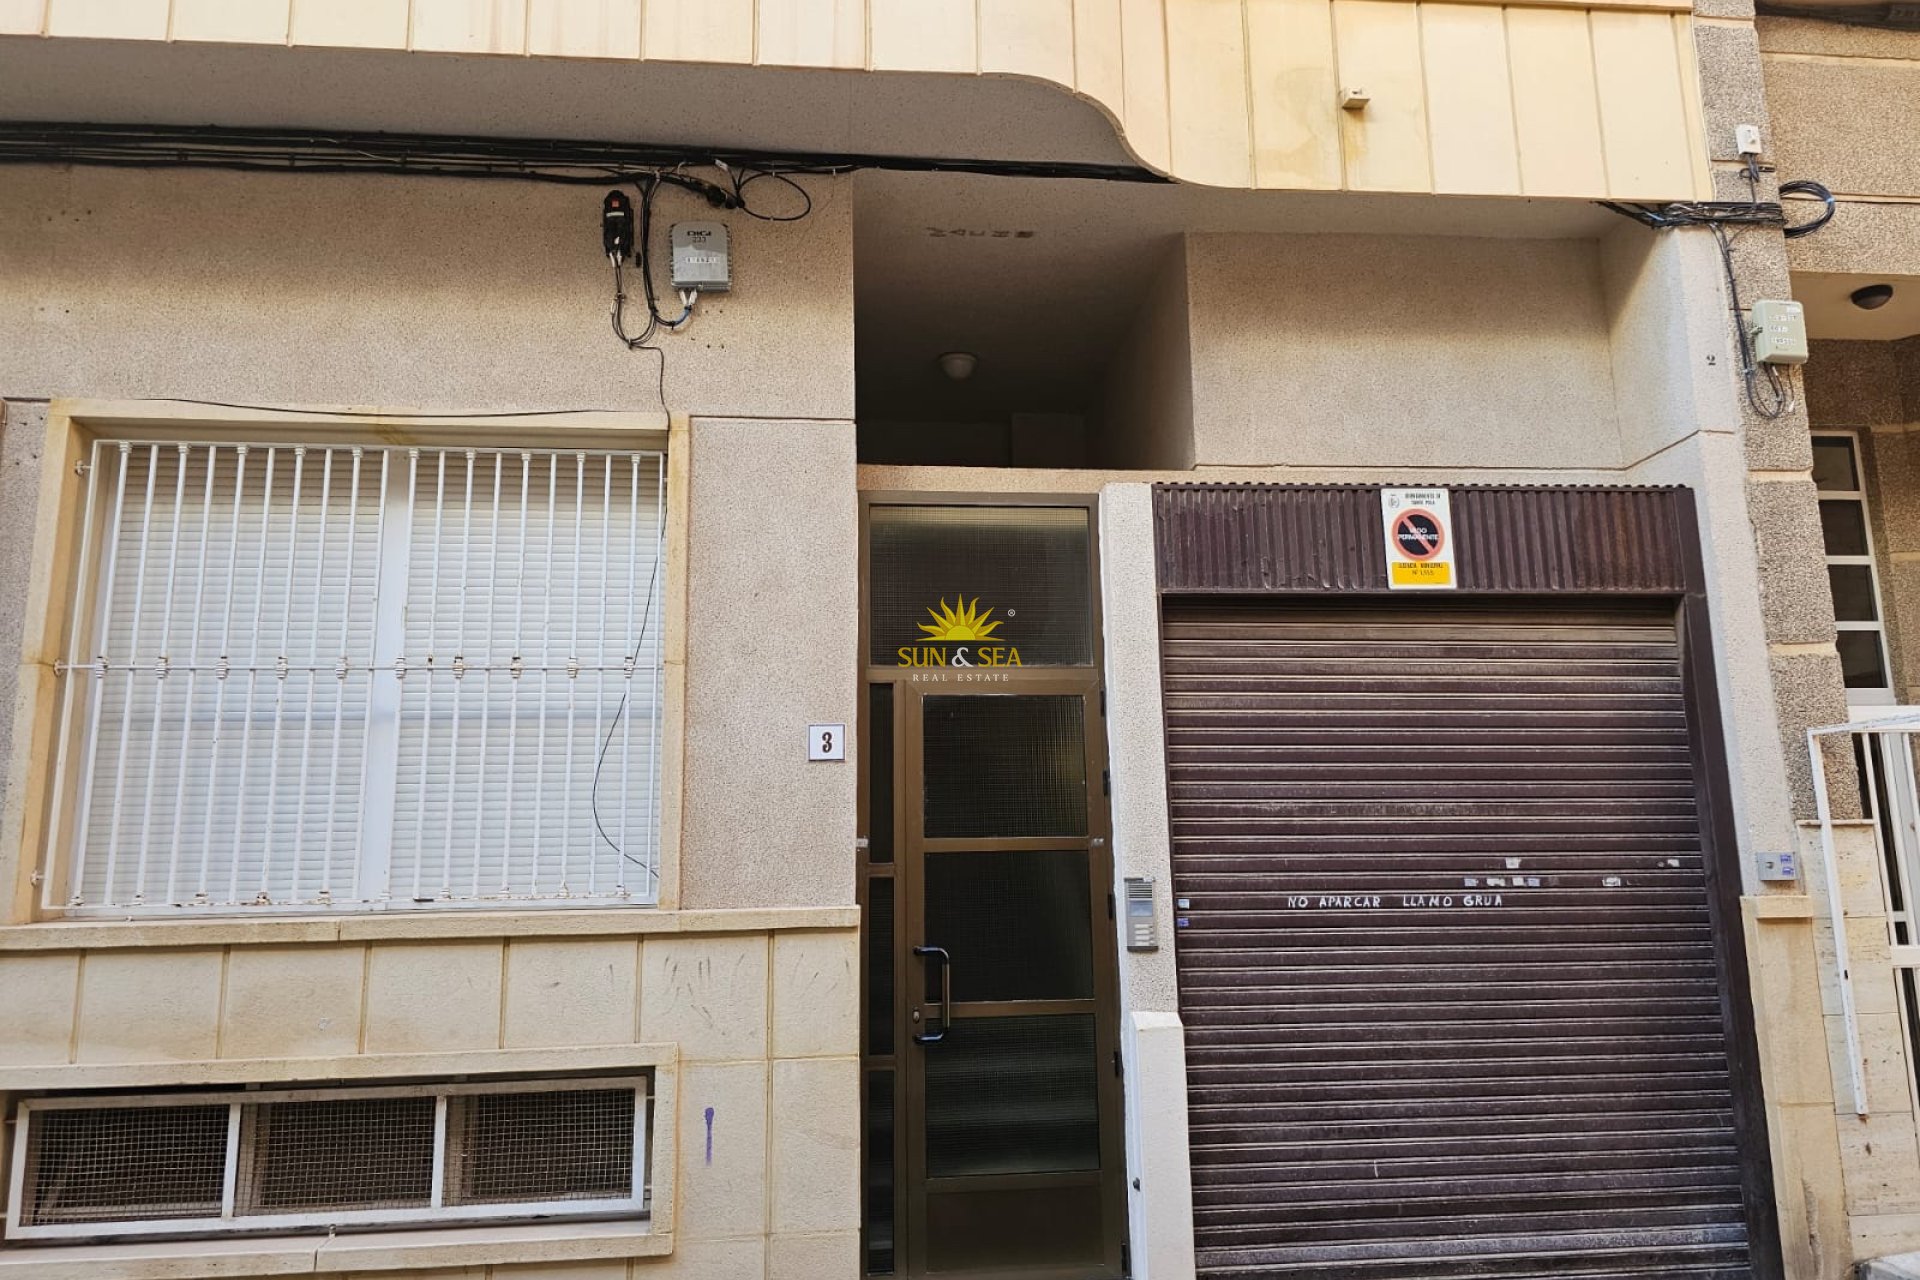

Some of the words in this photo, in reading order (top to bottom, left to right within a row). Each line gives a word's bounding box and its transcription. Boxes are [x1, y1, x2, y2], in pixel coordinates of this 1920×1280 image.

[822, 732, 832, 753] 3
[1288, 896, 1308, 908] NO
[1319, 896, 1381, 908] APARCAR
[1403, 895, 1453, 907] LLAMO
[1463, 894, 1502, 906] GRUA
